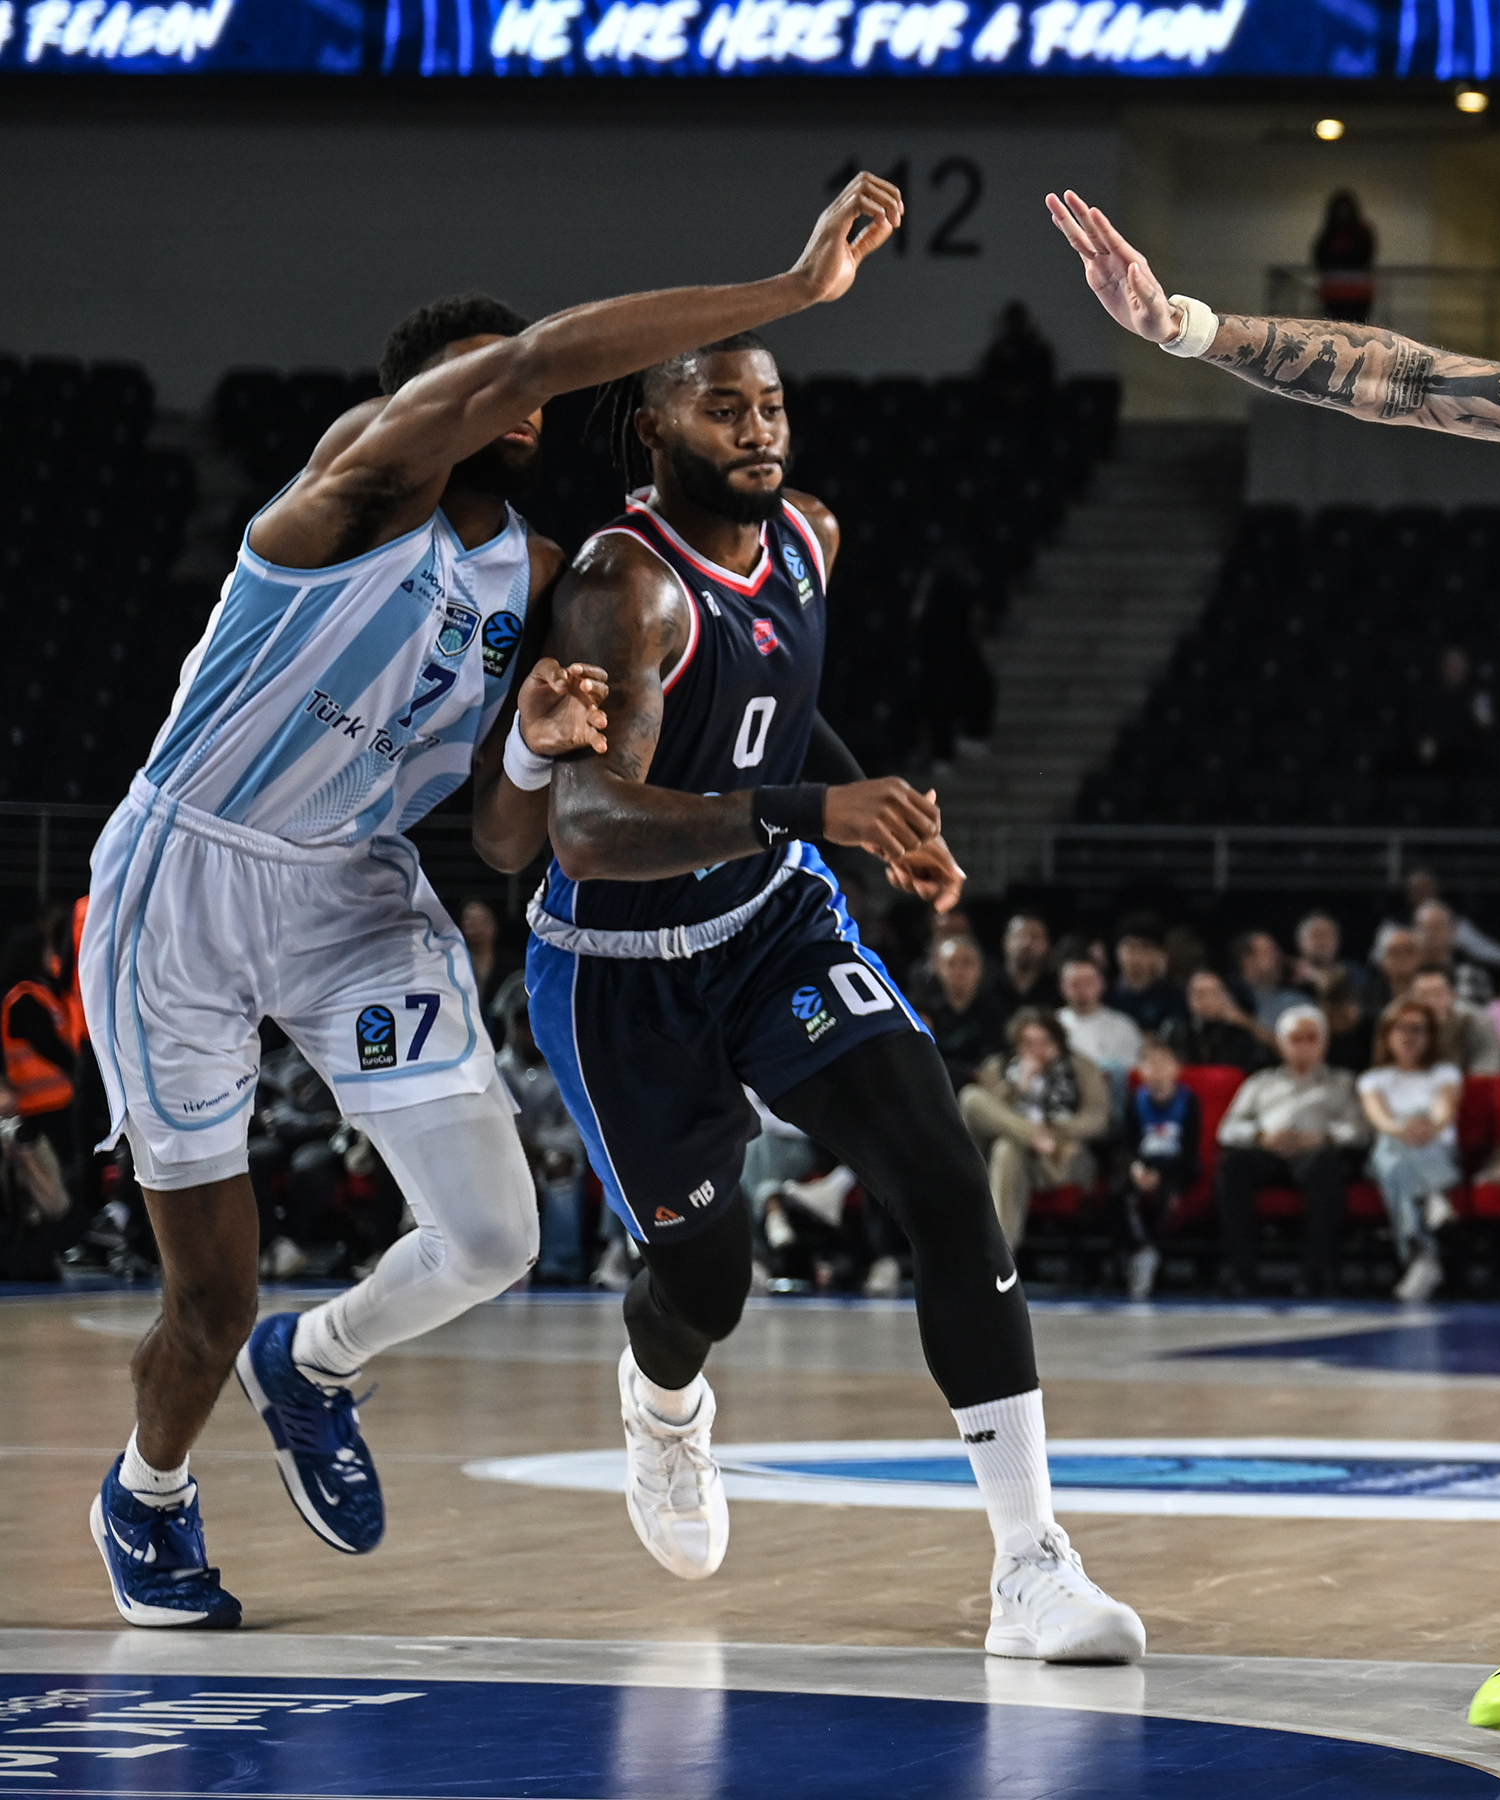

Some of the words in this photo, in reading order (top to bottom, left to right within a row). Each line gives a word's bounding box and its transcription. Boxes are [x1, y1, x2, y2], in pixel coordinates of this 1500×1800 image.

[25, 0, 235, 63] REASON
[490, 0, 586, 62] WE
[585, 0, 700, 62] ARE
[699, 0, 855, 71] HERE
[851, 0, 969, 67] FOR
[971, 0, 1020, 62] A
[1029, 0, 1248, 67] REASON
[825, 155, 984, 258] 12
[304, 689, 366, 739] Türk
[397, 661, 458, 728] 7
[732, 695, 778, 770] 0
[827, 961, 895, 1017] 0
[364, 1043, 388, 1056] BKT
[405, 993, 441, 1062] 7
[362, 1054, 394, 1066] EuroCup
[4, 1692, 428, 1737] Türk
